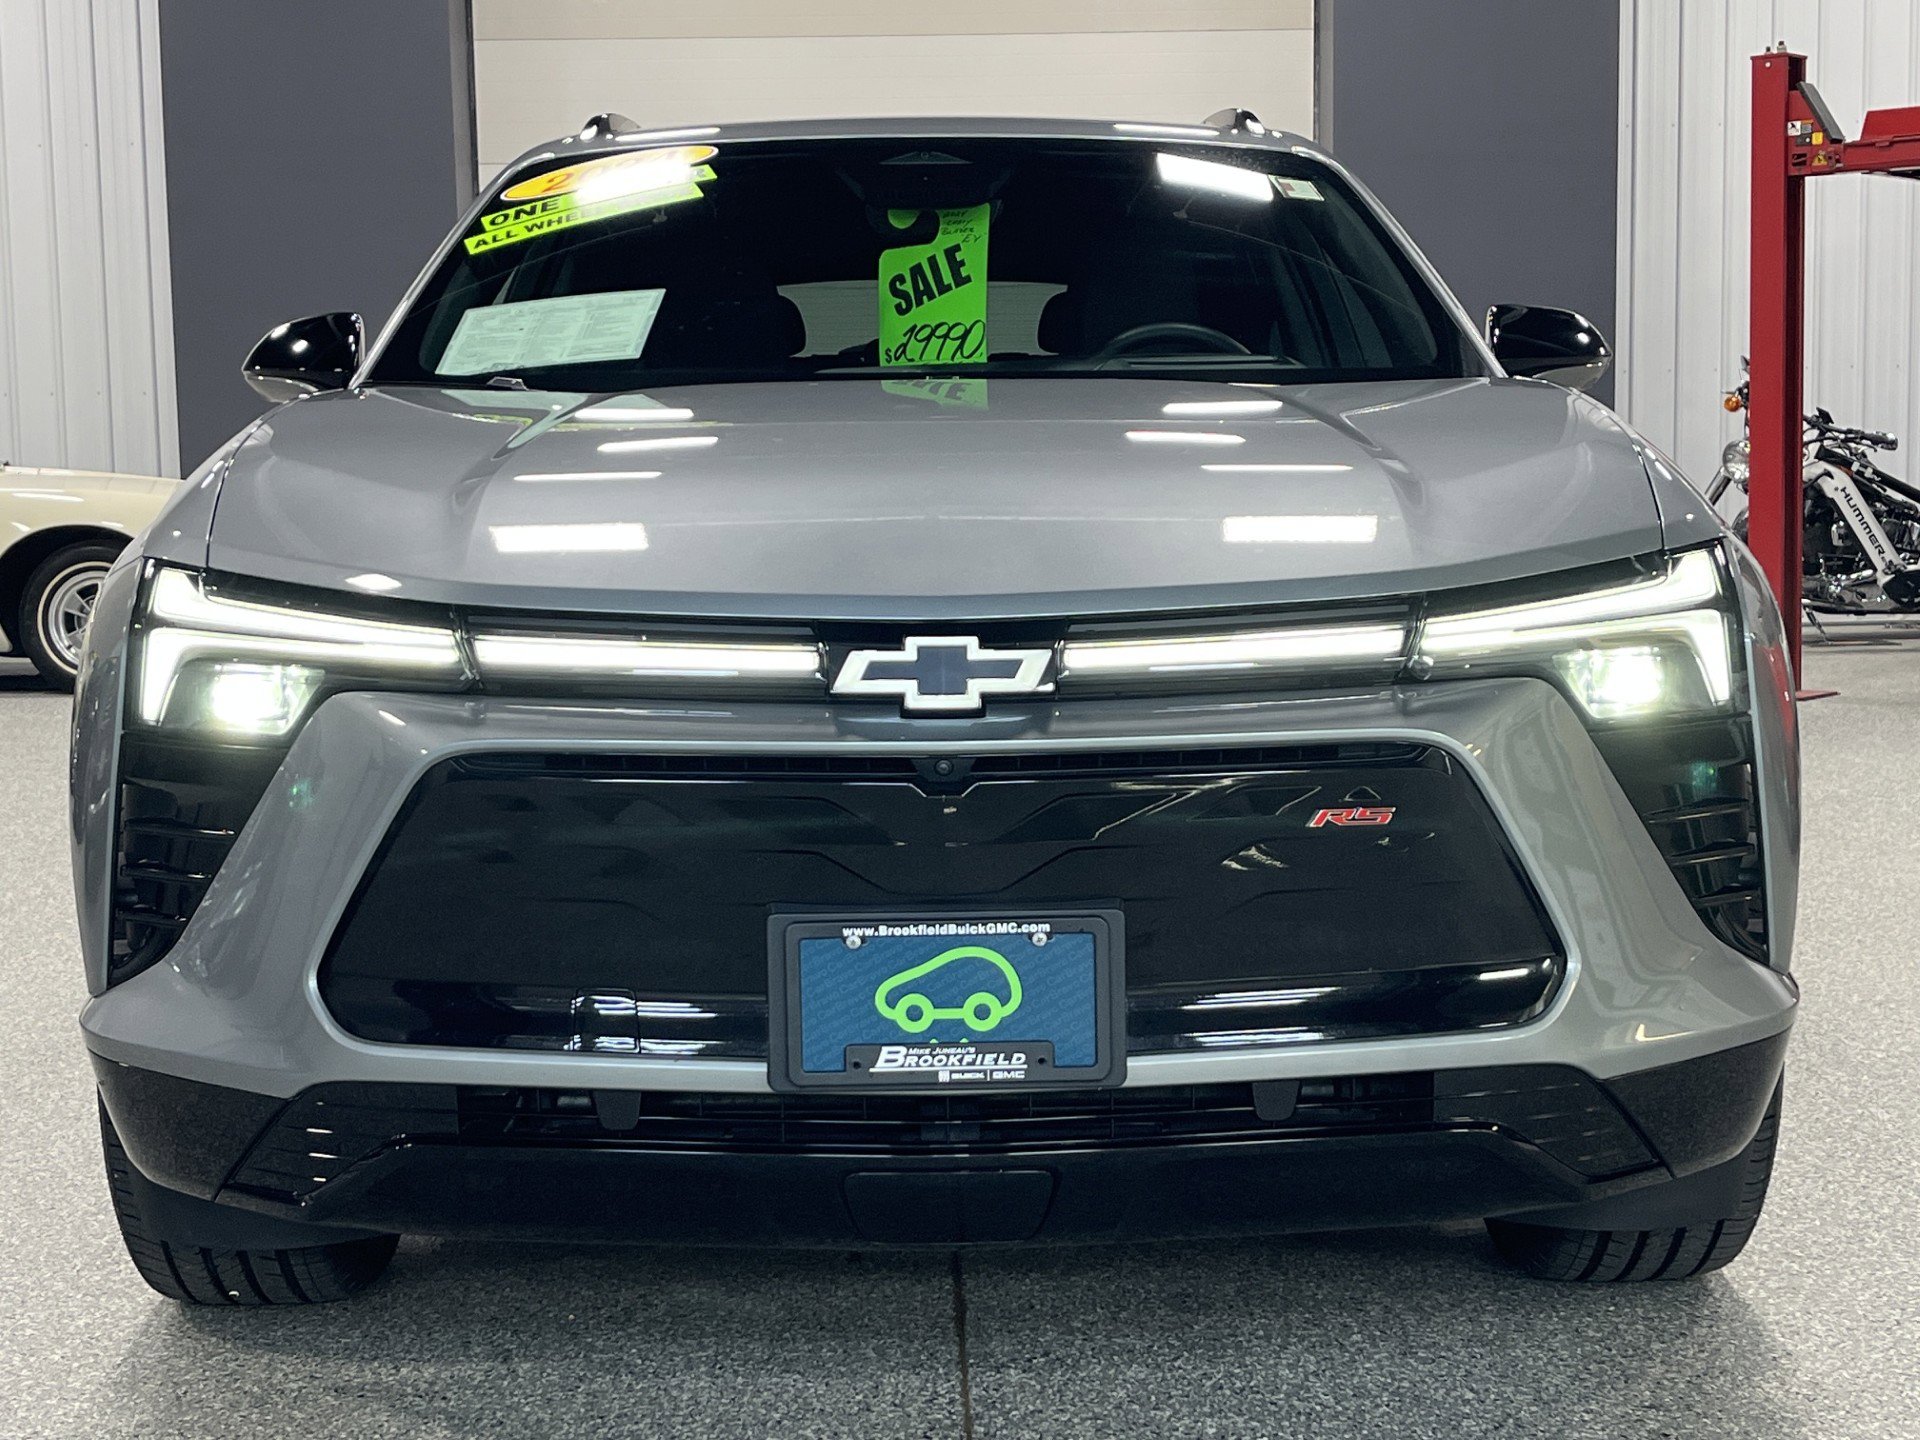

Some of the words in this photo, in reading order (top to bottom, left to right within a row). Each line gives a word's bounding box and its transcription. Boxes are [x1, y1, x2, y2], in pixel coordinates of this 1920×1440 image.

[489, 198, 560, 227] ONE
[473, 229, 520, 249] ALL
[888, 243, 972, 317] SALE
[1840, 486, 1886, 557] HUMMER
[1307, 807, 1396, 827] RS
[842, 922, 1050, 936] www.BrookfieldBuickGMC.com
[874, 1045, 1026, 1068] BROOKFIELD
[992, 1070, 1025, 1079] GMC
